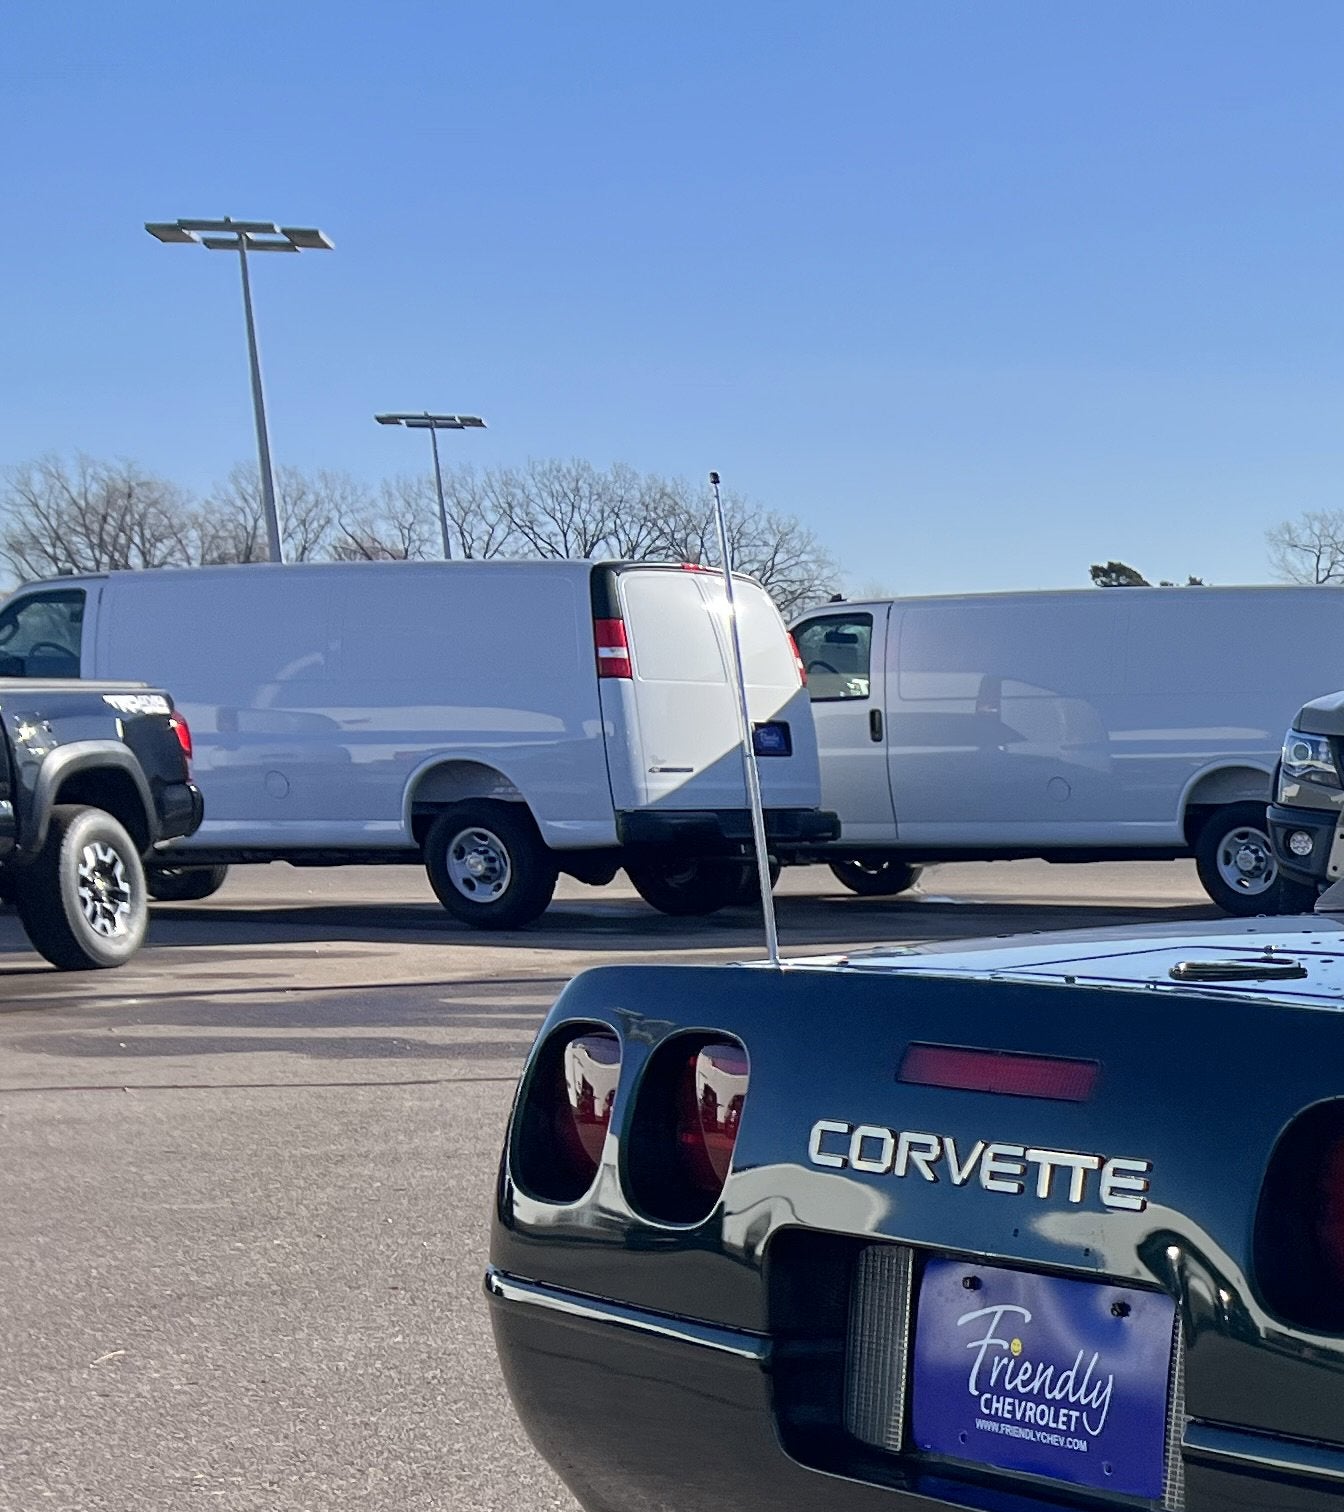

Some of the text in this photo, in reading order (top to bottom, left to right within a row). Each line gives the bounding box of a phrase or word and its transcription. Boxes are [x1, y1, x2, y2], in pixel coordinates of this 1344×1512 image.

[809, 1119, 1153, 1212] CORVETTE
[957, 1304, 1113, 1437] Friendly
[975, 1418, 1089, 1452] WWW.FRIENDLYCHEV.COM
[980, 1393, 1080, 1432] CHEVROLET
